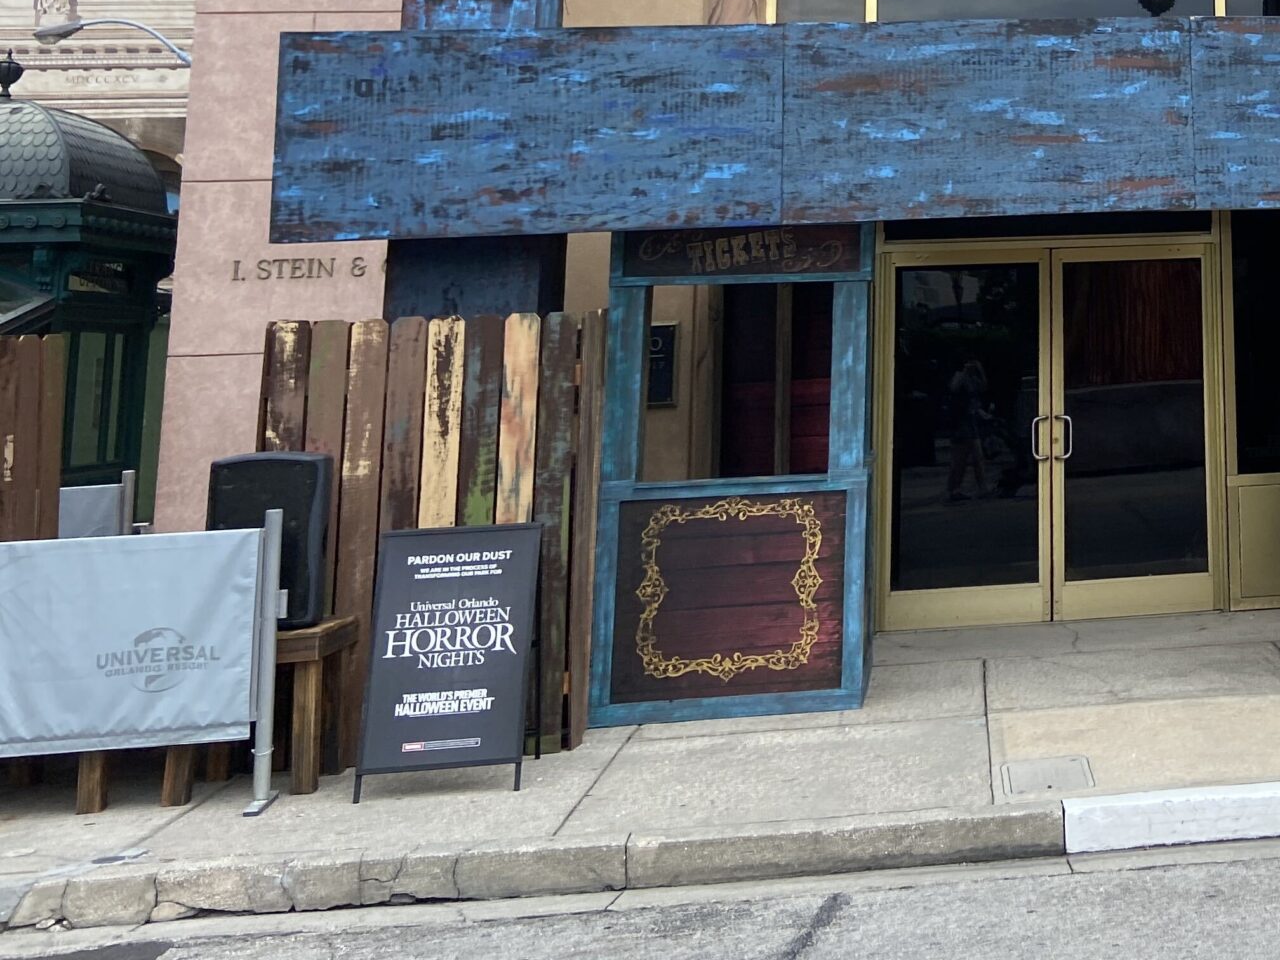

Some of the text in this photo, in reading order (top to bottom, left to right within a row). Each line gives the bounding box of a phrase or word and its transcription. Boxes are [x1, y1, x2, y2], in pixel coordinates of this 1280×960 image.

[686, 226, 798, 273] TICKETS
[232, 260, 246, 282] I.
[256, 257, 337, 281] STEIN
[351, 256, 368, 277] &
[407, 549, 513, 566] PARDON OUR DUST
[410, 596, 499, 612] Universal Orlando
[394, 606, 511, 629] HALLOWEEN
[382, 623, 517, 658] HORROR
[96, 644, 221, 670] UNIVERSAL
[417, 649, 485, 669] NIGHTS
[104, 664, 162, 678] ORLANDO
[394, 696, 496, 717] HALLOWEEN EVENT
[402, 688, 488, 704] THE WORLD'S PREMIER
